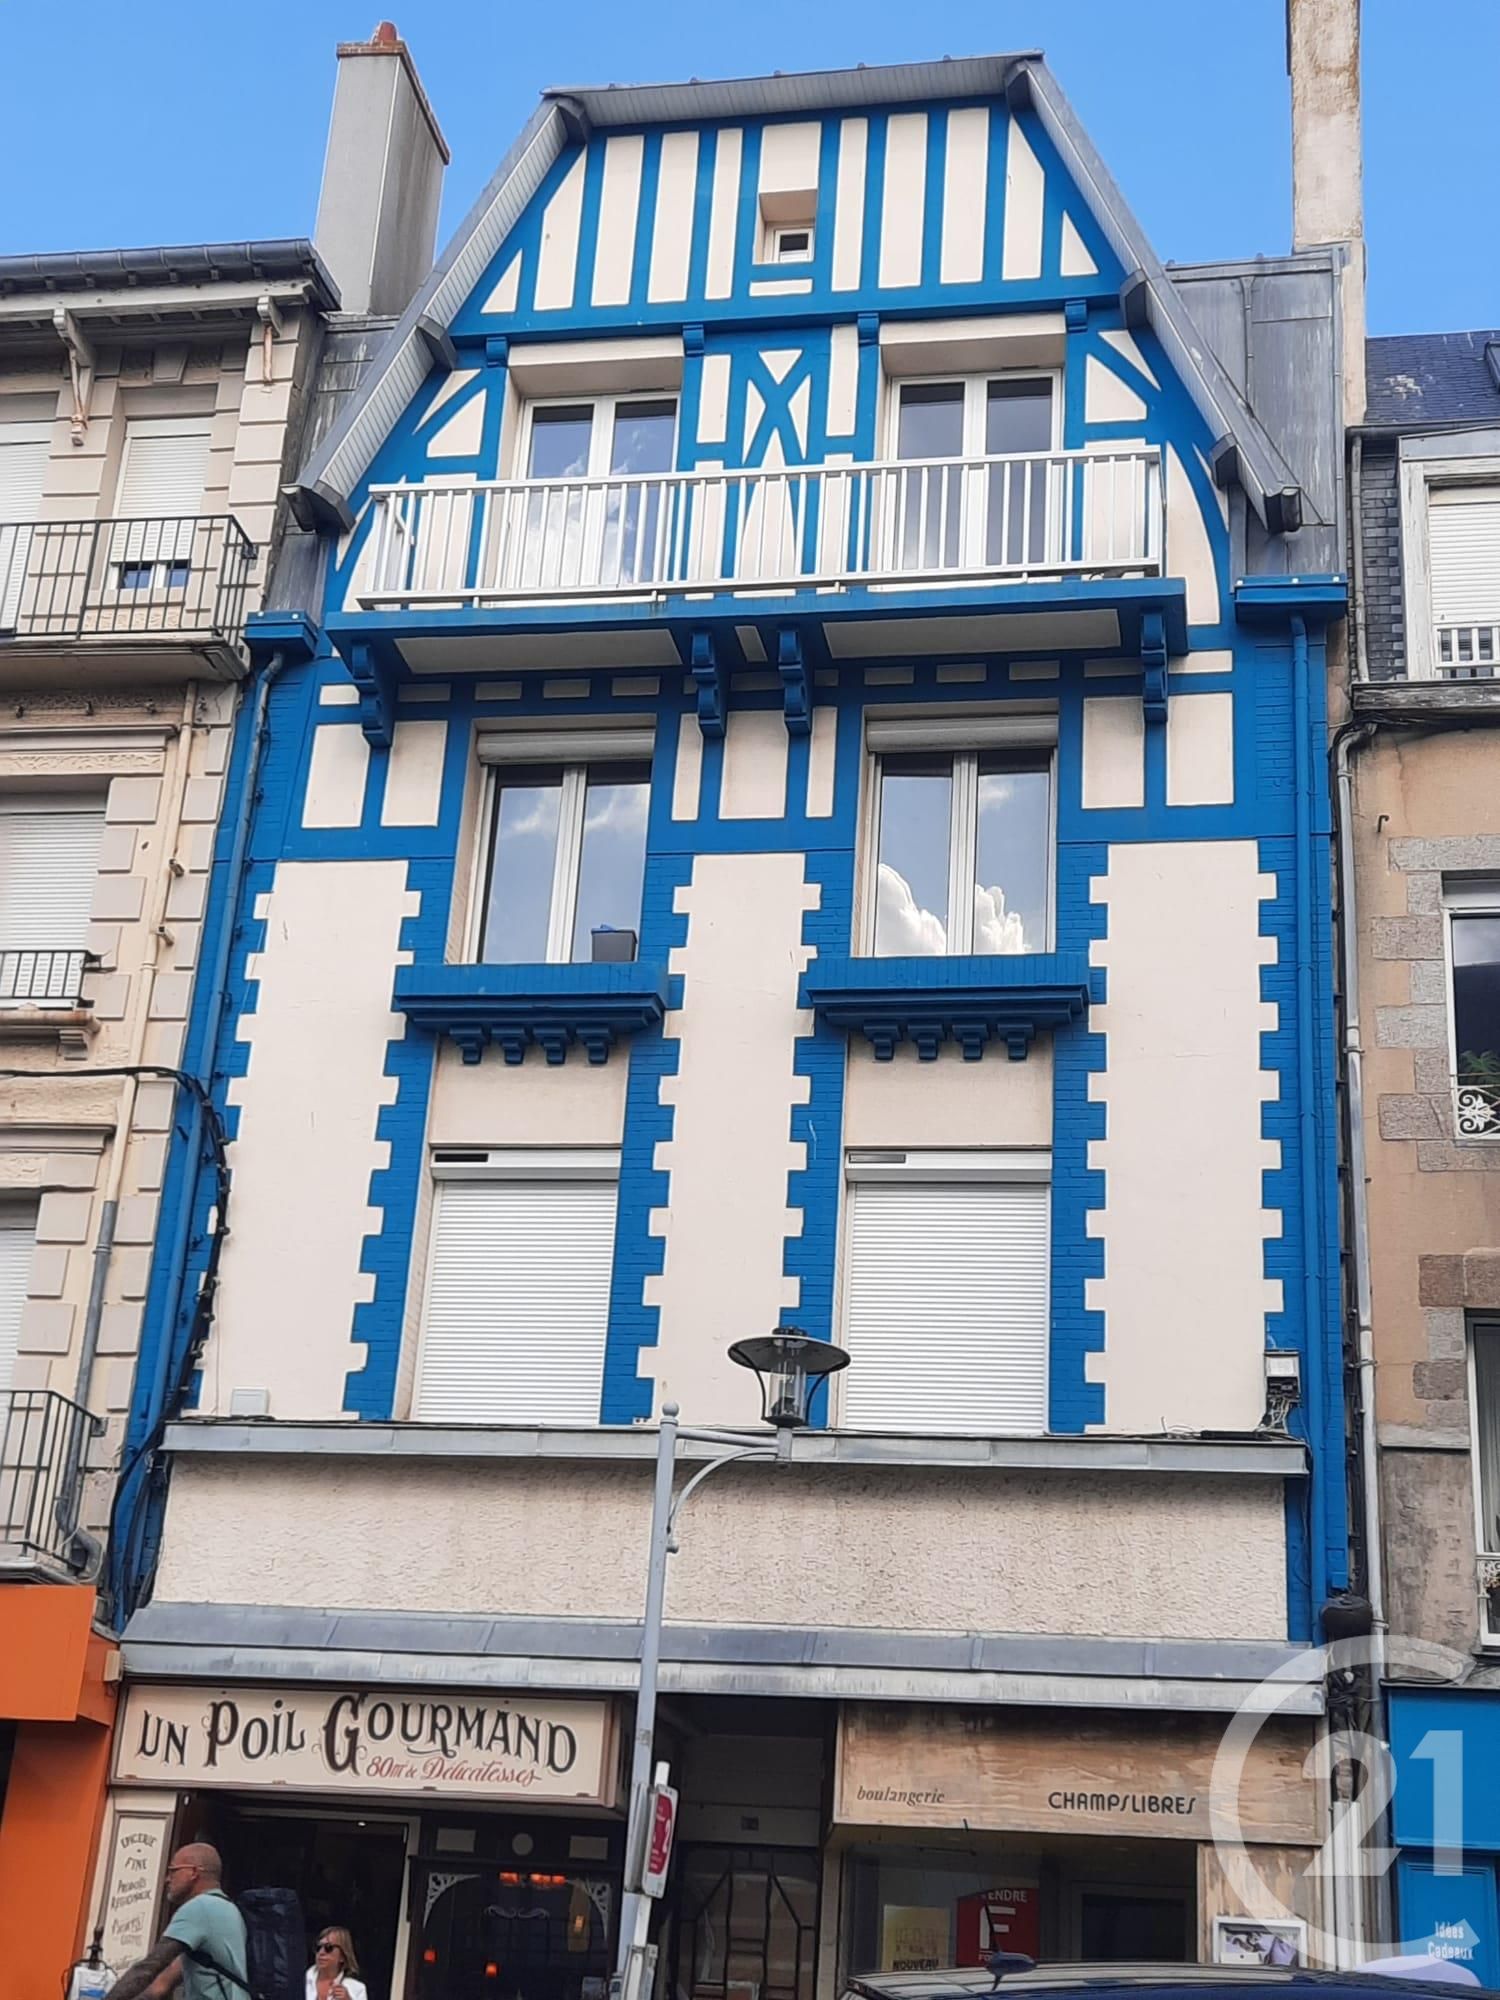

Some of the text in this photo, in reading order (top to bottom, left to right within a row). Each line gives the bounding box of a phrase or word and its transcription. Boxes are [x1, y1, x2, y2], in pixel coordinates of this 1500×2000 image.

[134, 1710, 189, 1766] UN
[320, 1692, 578, 1776] GOURMAND
[856, 1784, 946, 1807] boulangerie
[980, 1889, 1028, 1903] ENDRE
[1427, 1941, 1474, 1961] Cadeaux
